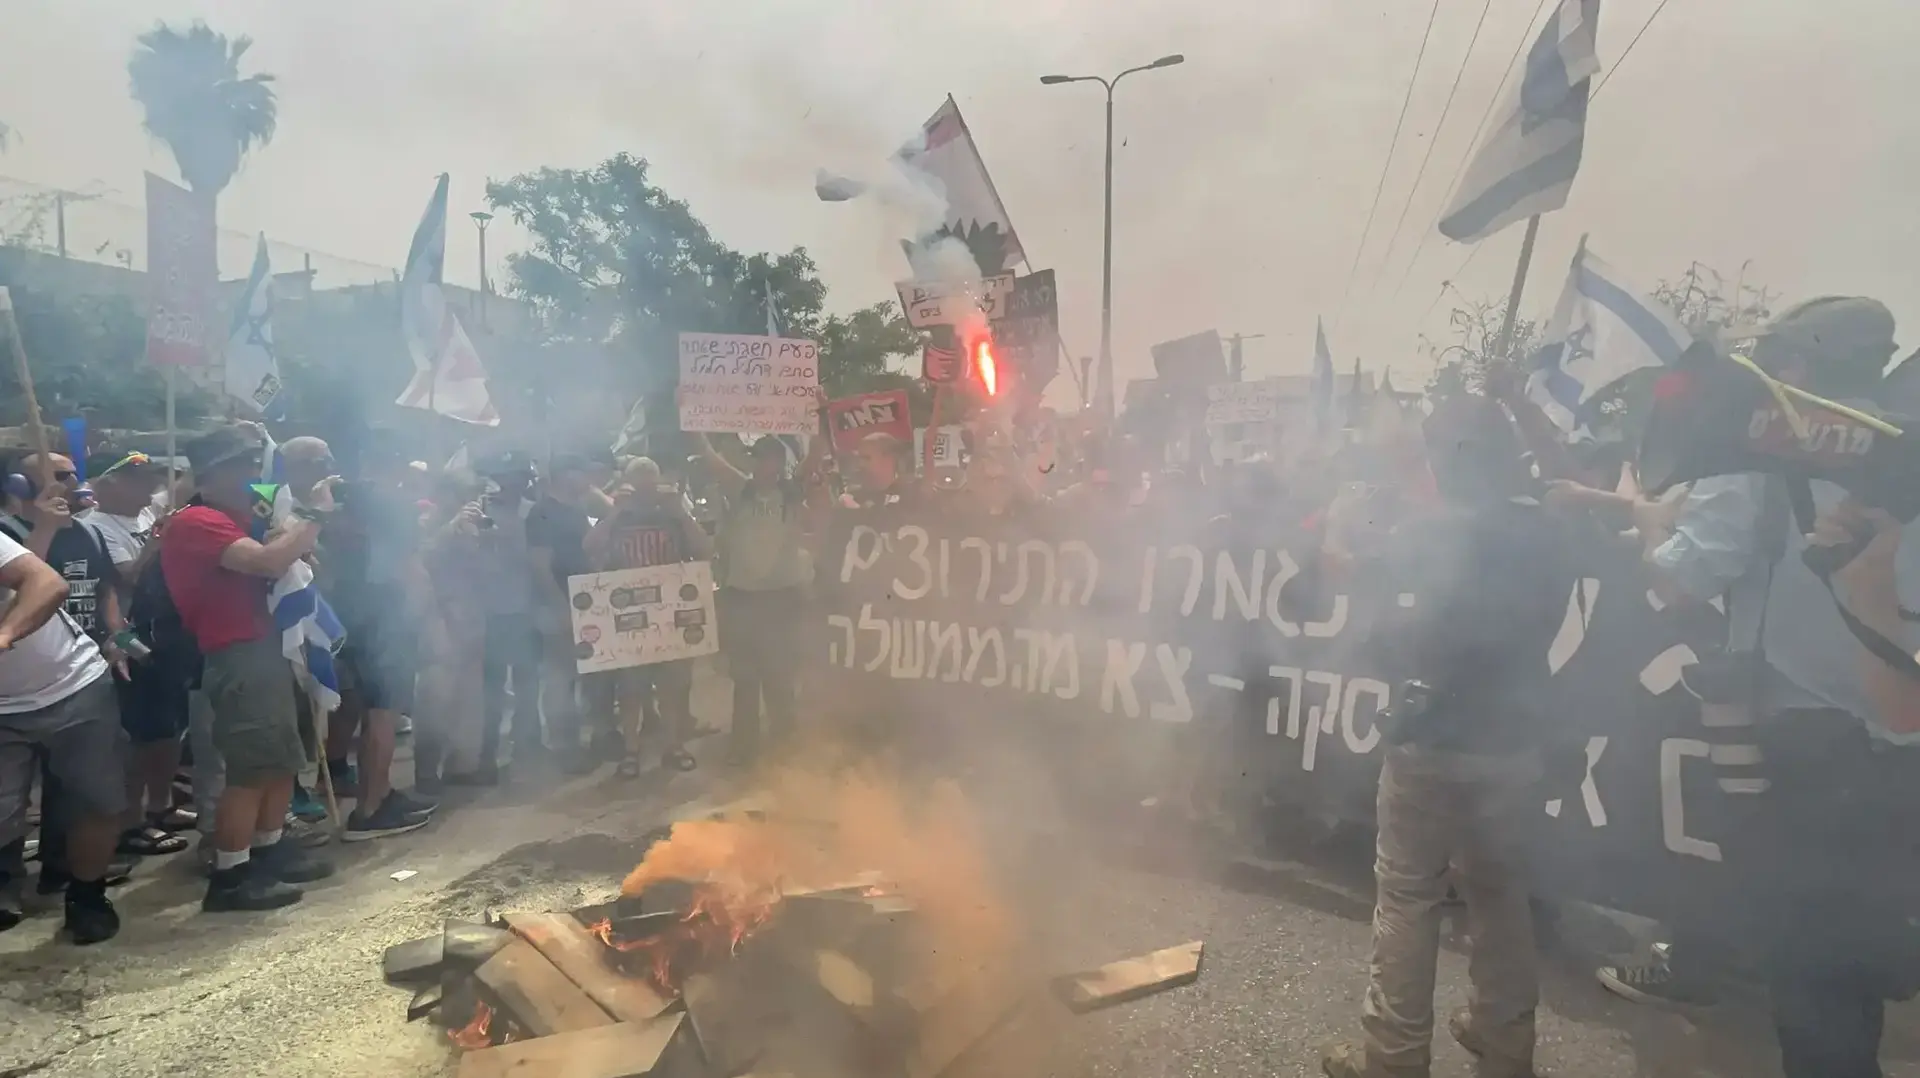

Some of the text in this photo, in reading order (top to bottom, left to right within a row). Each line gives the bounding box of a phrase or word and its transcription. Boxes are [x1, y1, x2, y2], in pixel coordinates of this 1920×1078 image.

[724, 340, 772, 359] חשבתי
[779, 343, 816, 359] פעם
[839, 524, 1099, 606] התירוצים
[827, 604, 1080, 701] מהממשלה
[1099, 638, 1193, 723] צא
[1266, 665, 1391, 772] סקה
